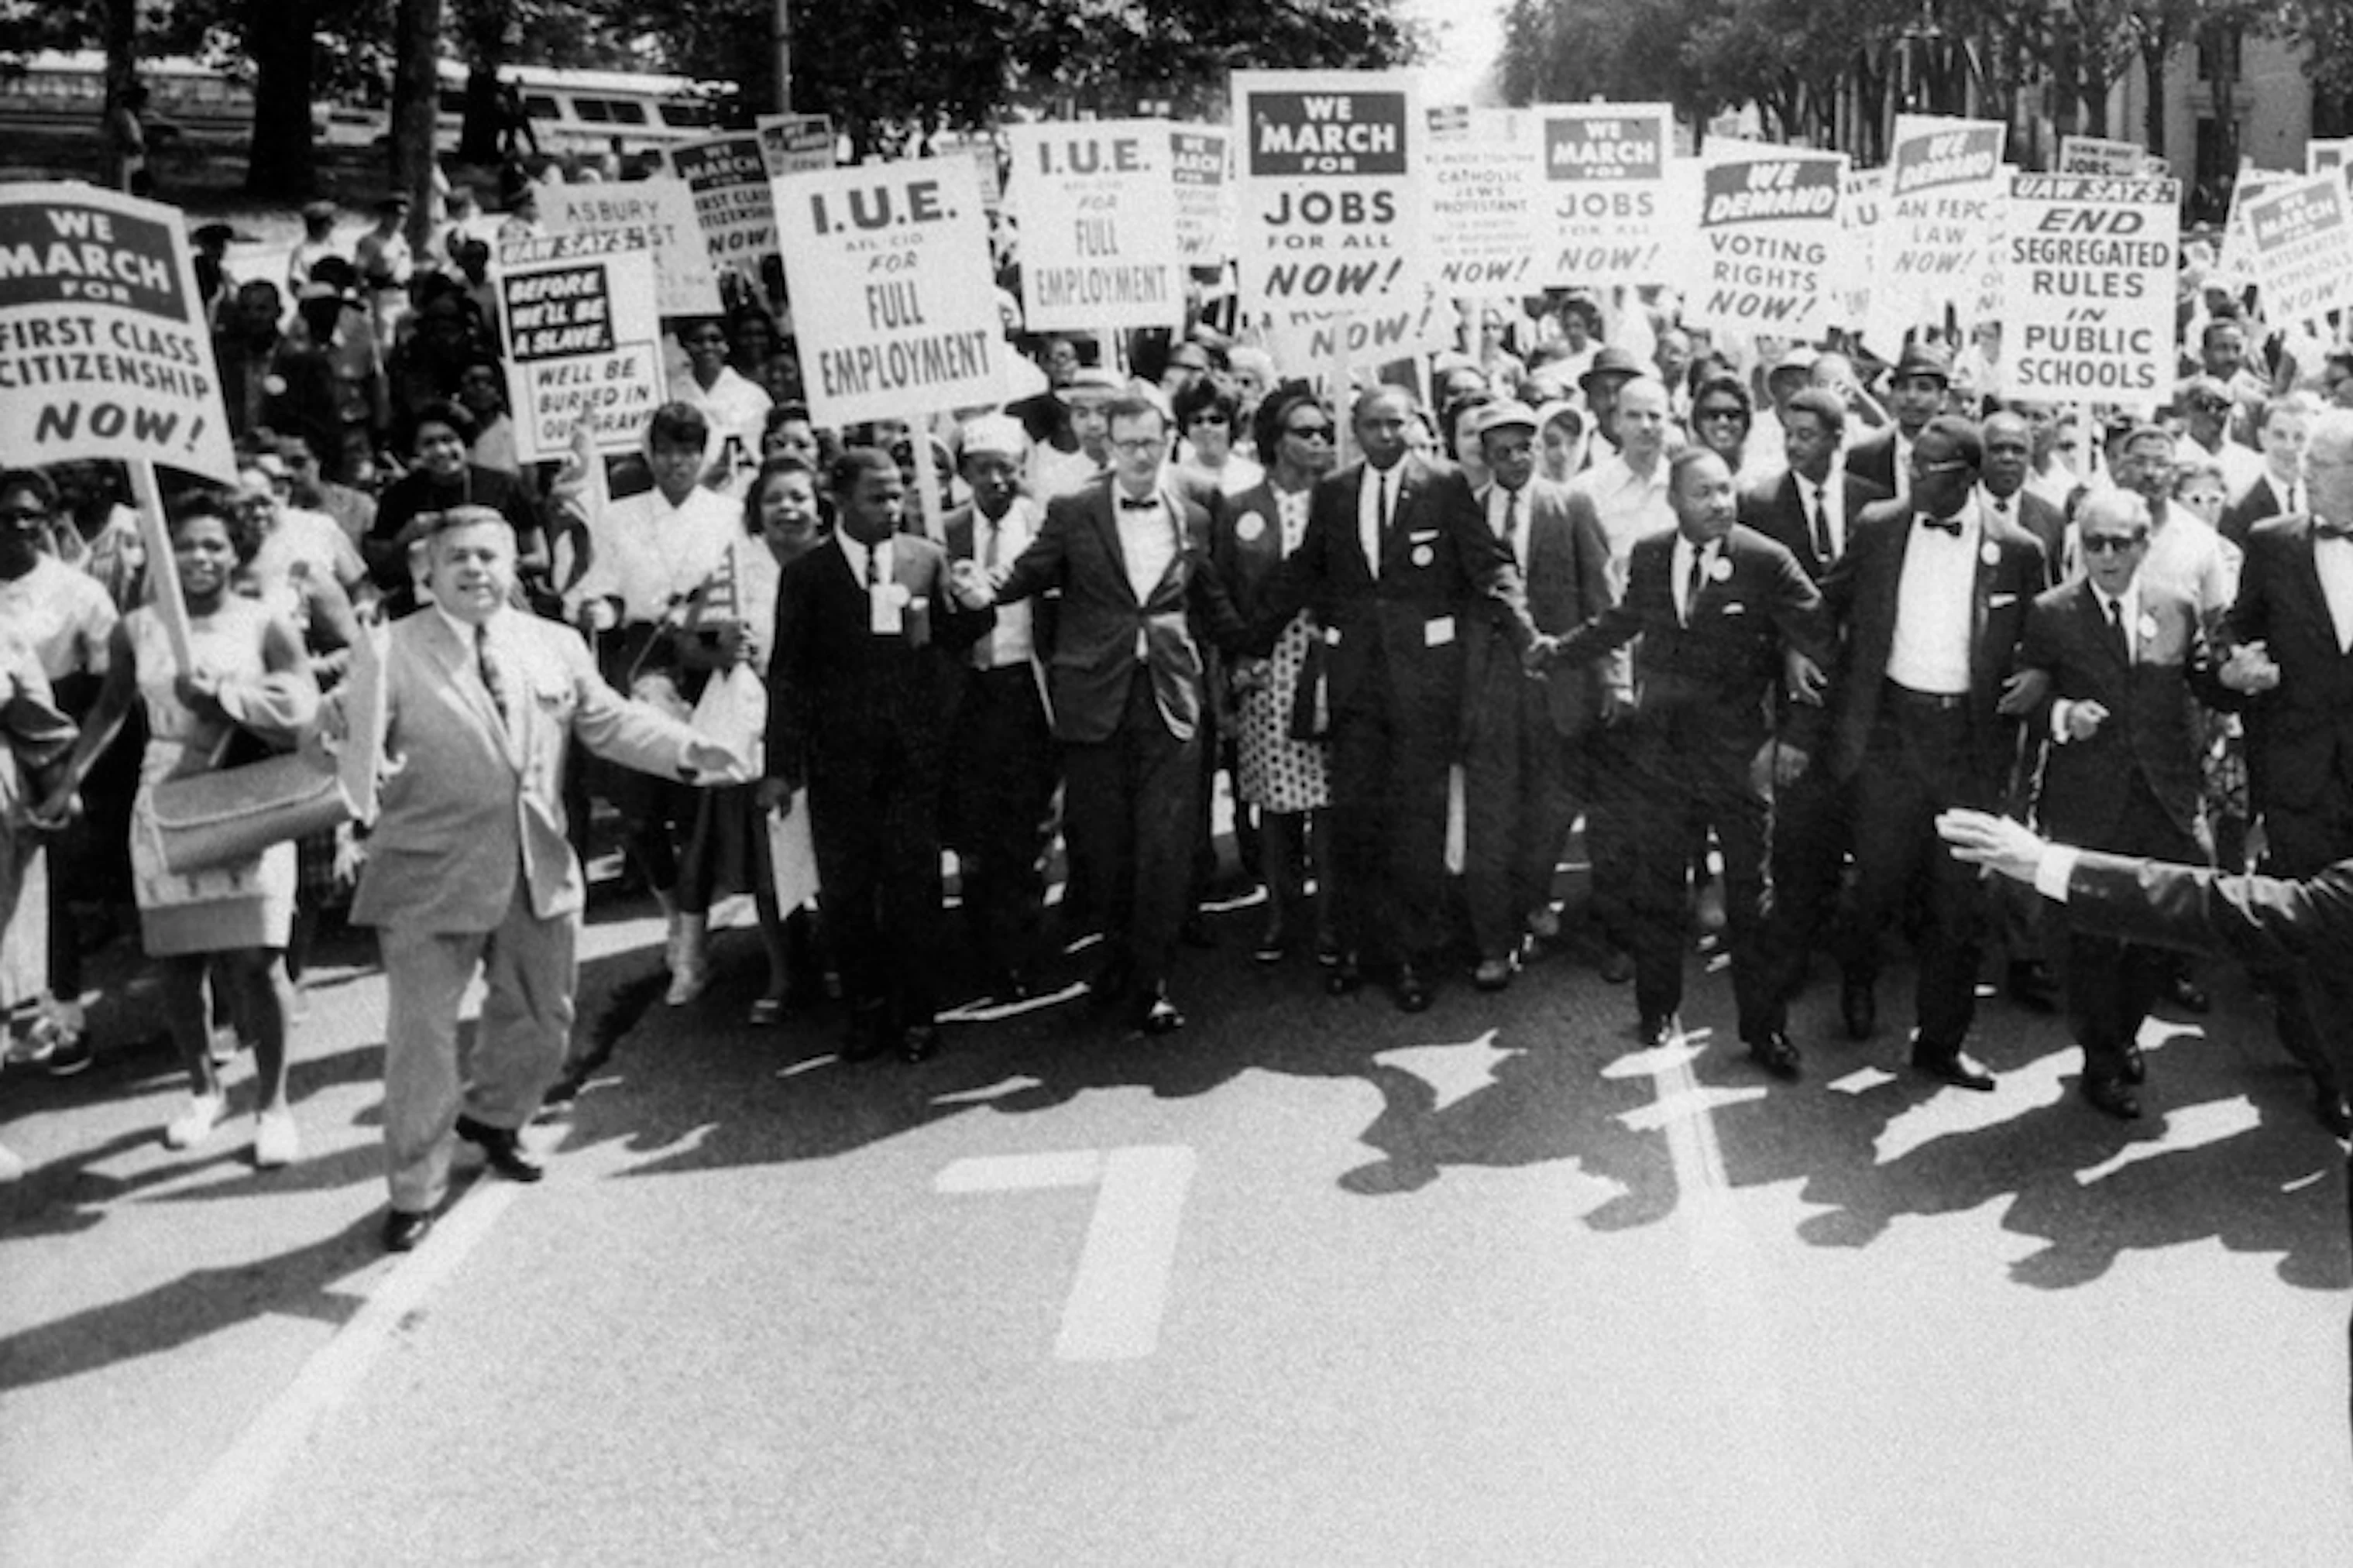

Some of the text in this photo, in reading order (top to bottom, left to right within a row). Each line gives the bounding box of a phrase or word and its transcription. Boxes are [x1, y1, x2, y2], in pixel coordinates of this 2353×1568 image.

[1302, 96, 1352, 121] WE
[1259, 123, 1396, 153] MARCH
[1584, 120, 1621, 139] WE
[1038, 138, 1152, 177] I.U.E.
[1552, 141, 1655, 165] MARCH
[1928, 133, 1969, 160] WE
[683, 156, 762, 180] MARCH
[1302, 156, 1356, 172] FOR
[1747, 163, 1801, 189] WE
[1898, 153, 1994, 189] DEMAND
[2015, 179, 2081, 199] UAW
[565, 198, 658, 222] ASBURY
[810, 180, 957, 235] I.U.E.
[1262, 190, 1396, 225] JOBS
[1556, 191, 1654, 218] JOBS
[1707, 186, 1835, 223] DEMAND
[1897, 200, 1927, 218] AN
[2259, 197, 2337, 238] MARCH
[46, 209, 115, 243] WE
[1913, 225, 1967, 244] LAW
[2038, 208, 2145, 234] END
[1074, 218, 1119, 258] FULL
[1267, 234, 1392, 249] FOR ALL
[1709, 232, 1826, 265] VOTING
[2012, 236, 2168, 268] SEGREGATED
[0, 242, 171, 294] MARCH
[867, 249, 918, 273] FOR
[1441, 256, 1530, 284] NOW!
[1556, 242, 1660, 272] NOW!
[1894, 249, 1977, 273] NOW!
[1036, 265, 1167, 307] EMPLOYMENT
[1265, 256, 1403, 297] NOW!
[1714, 261, 1818, 293] RIGHTS
[2032, 270, 2144, 298] RULES
[60, 281, 132, 303] FOR
[865, 280, 925, 331] FULL
[1707, 290, 1817, 323] NOW!
[2065, 308, 2107, 323] IN
[0, 317, 200, 366] FIRST CLASS
[1310, 306, 1433, 359] NOW!
[2025, 325, 2152, 355] PUBLIC
[0, 352, 211, 400] CITIZENSHIP
[604, 357, 635, 379] BE
[819, 330, 990, 397] EMPLOYMENT
[2017, 359, 2156, 388] SCHOOLS
[34, 400, 206, 453] NOW!
